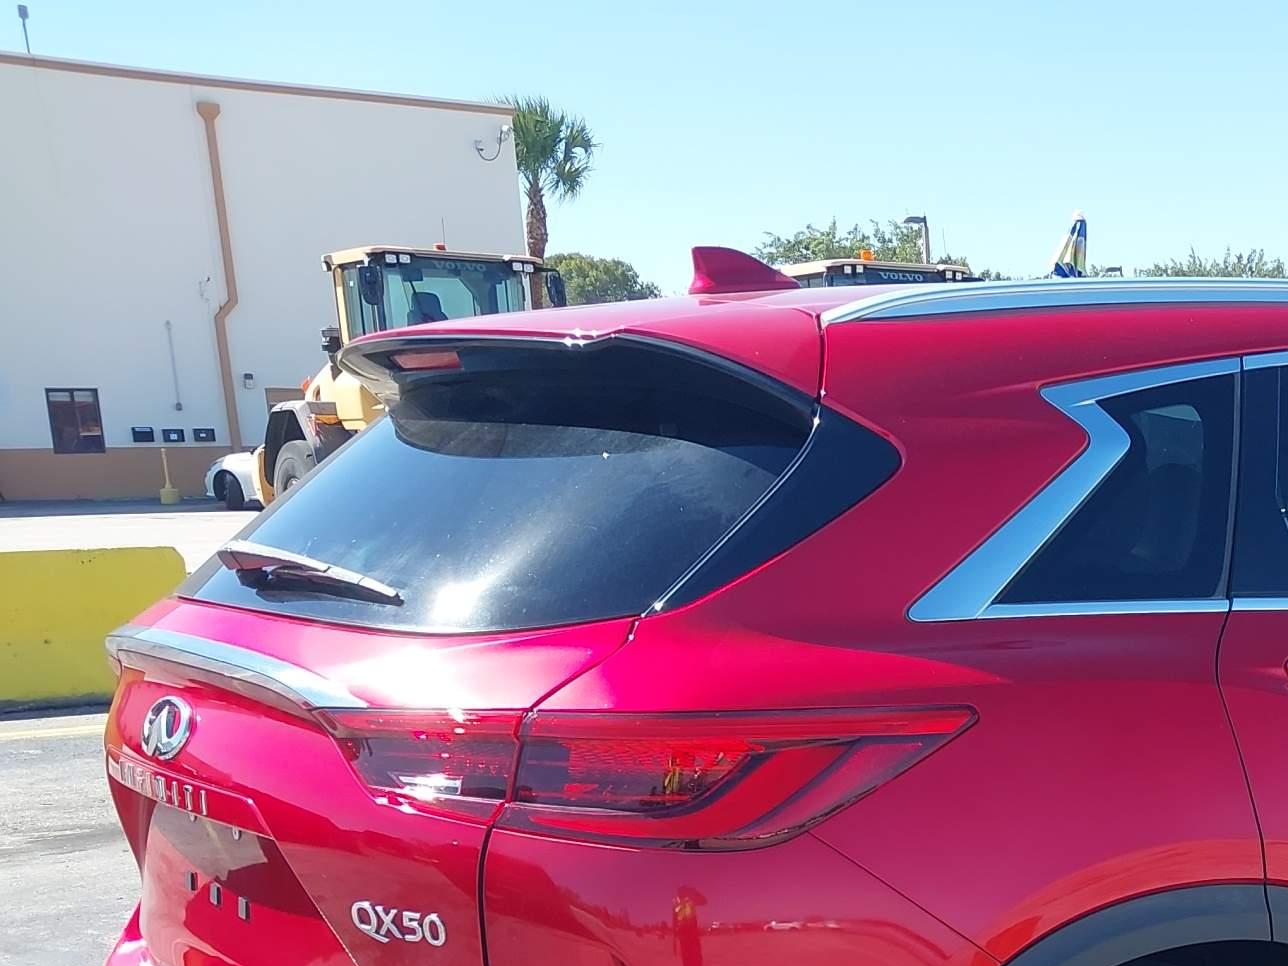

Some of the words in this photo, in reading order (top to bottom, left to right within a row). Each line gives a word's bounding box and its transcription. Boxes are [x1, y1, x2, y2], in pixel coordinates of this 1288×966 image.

[432, 260, 487, 272] VOLVO
[878, 271, 924, 282] VOLVO
[351, 900, 447, 947] QX50
